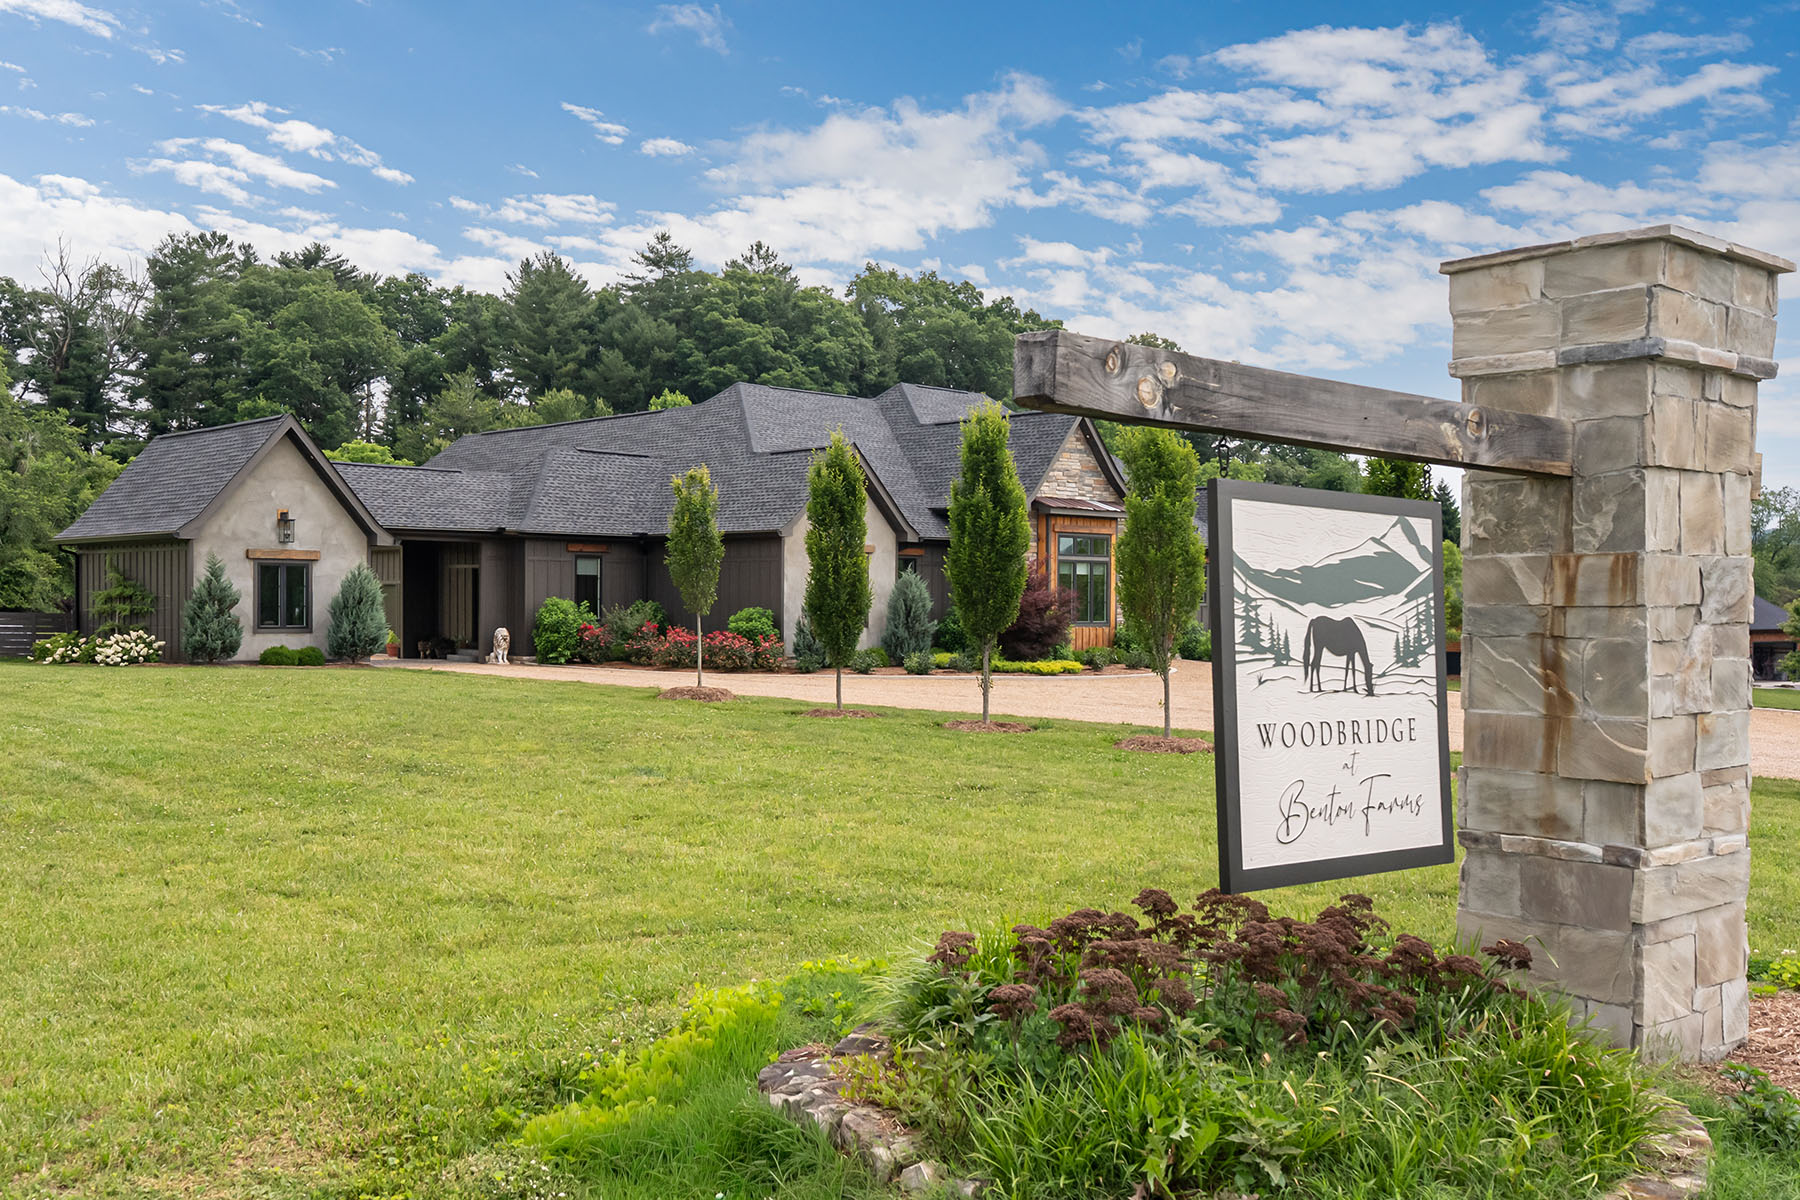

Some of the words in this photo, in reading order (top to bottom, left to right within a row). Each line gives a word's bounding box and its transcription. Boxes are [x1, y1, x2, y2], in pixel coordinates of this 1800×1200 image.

[1256, 717, 1417, 748] WOODBRIDGE
[1342, 749, 1360, 776] at
[1276, 779, 1355, 844] Benton
[1359, 773, 1424, 837] Farms
